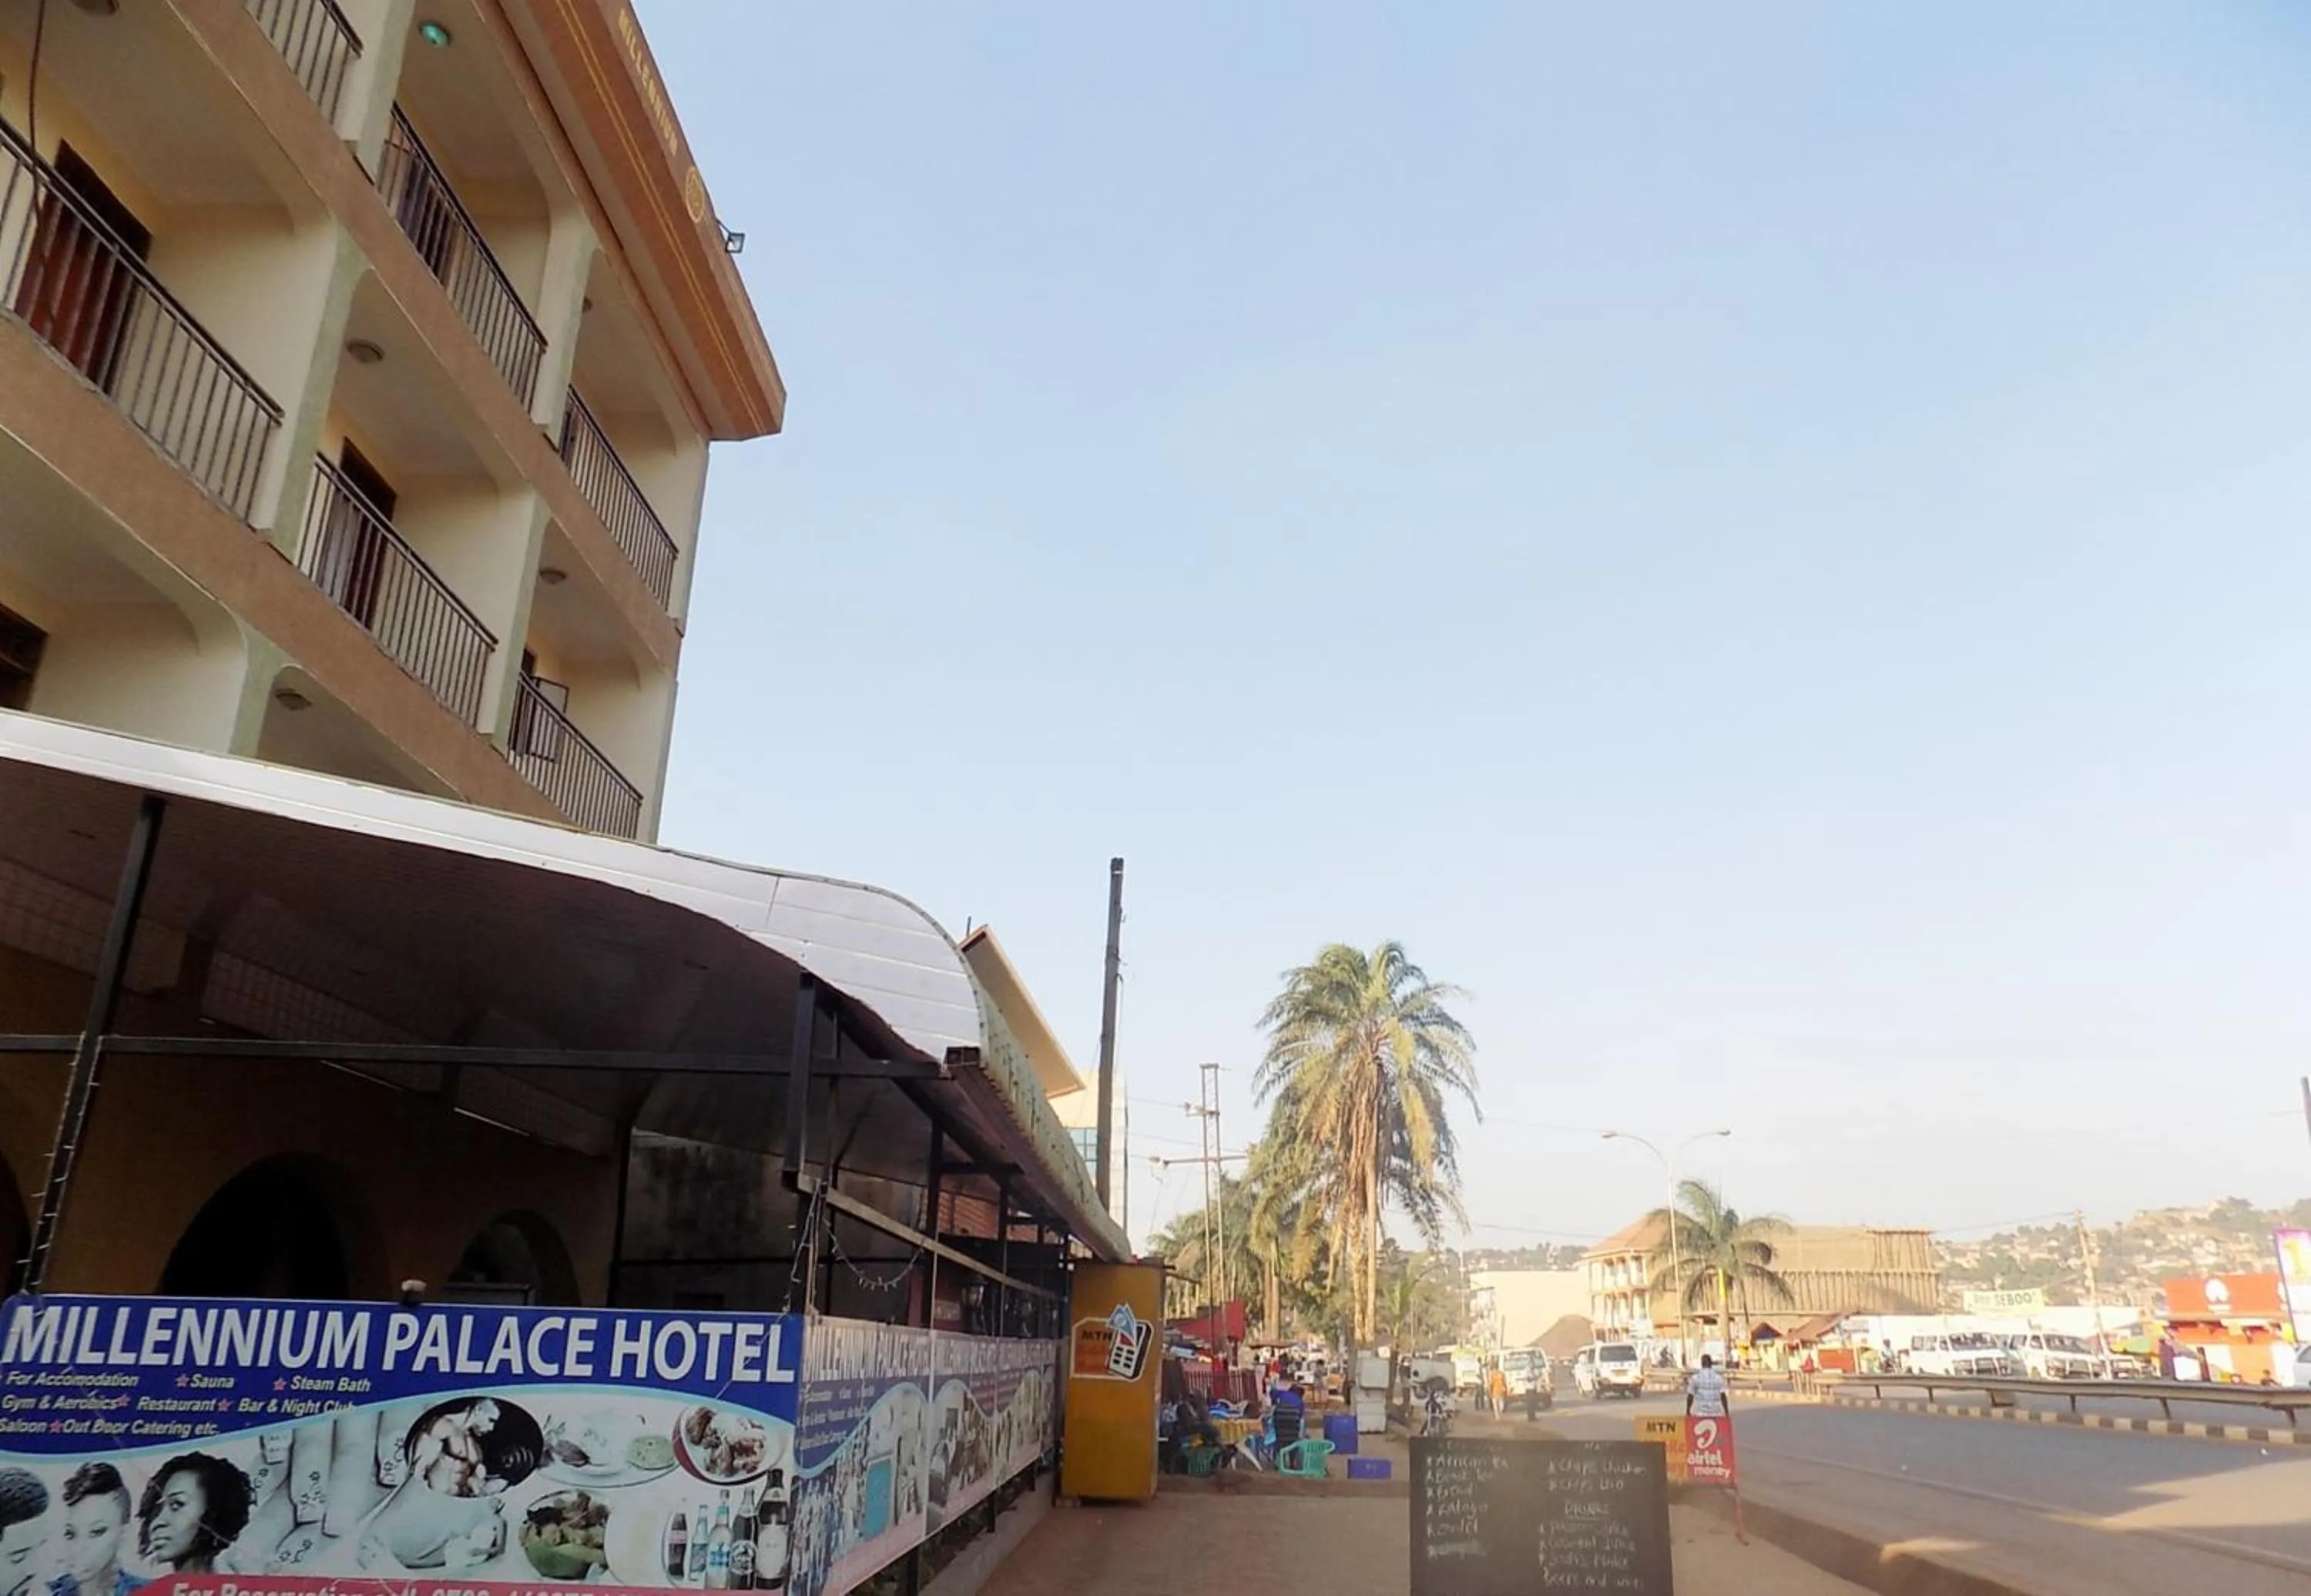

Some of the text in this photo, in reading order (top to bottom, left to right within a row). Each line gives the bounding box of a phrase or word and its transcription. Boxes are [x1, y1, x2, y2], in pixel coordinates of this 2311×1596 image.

[0, 1305, 795, 1383] MILLENNIUM PALACE HOTEL
[5, 1371, 34, 1385] For
[190, 1374, 235, 1389] Sauna
[290, 1375, 334, 1390] Steam
[337, 1376, 371, 1392] Bath
[2, 1394, 37, 1413] Gym
[39, 1395, 52, 1410] &
[52, 1395, 116, 1410] Aerobics
[136, 1396, 217, 1411] Restaurant
[237, 1398, 266, 1413] Bar
[267, 1399, 279, 1413] &
[280, 1399, 320, 1417] Night
[63, 1419, 92, 1433] Out
[94, 1419, 127, 1434] Door
[131, 1419, 192, 1439] Catering
[1645, 1421, 1677, 1433] MTN
[1687, 1449, 1724, 1466] airtel
